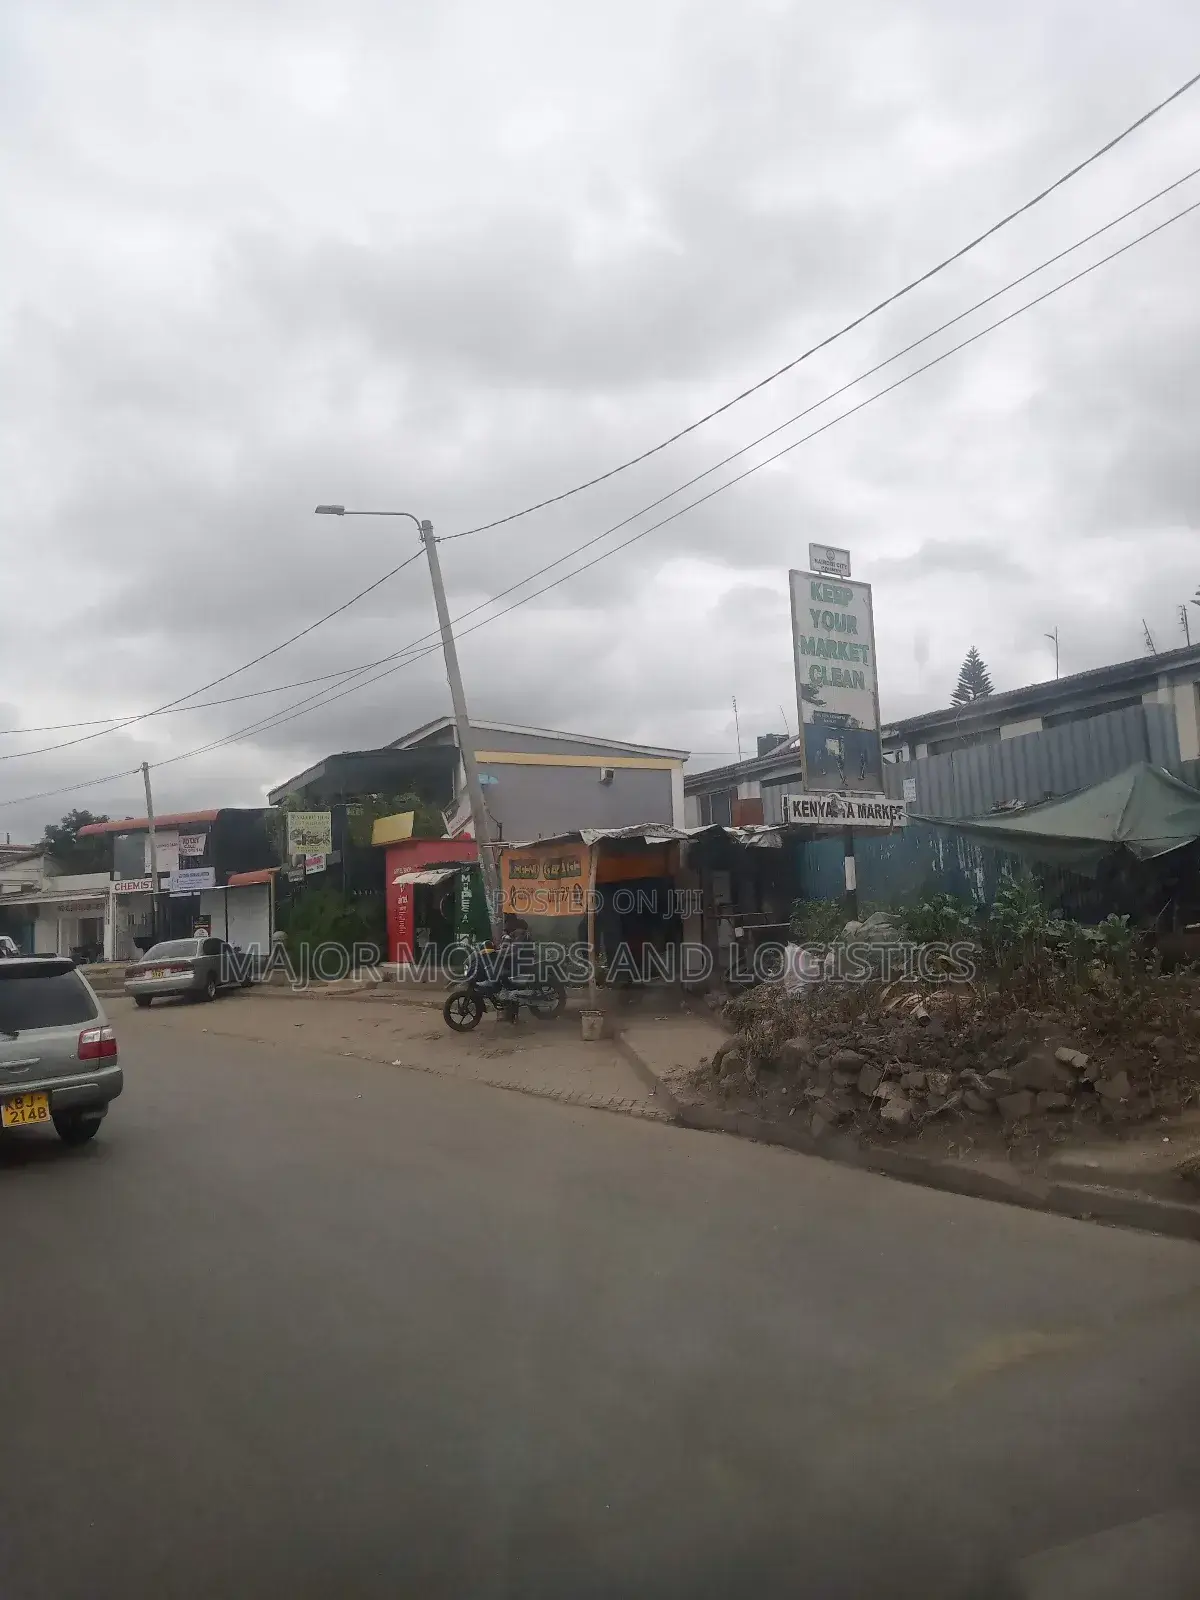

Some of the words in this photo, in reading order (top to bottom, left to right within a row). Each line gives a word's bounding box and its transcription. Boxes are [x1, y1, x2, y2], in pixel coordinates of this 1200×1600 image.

[810, 581, 854, 607] KEEP
[809, 608, 858, 636] YOUR
[799, 634, 870, 664] MARKET
[808, 664, 866, 690] CLEAN
[858, 804, 903, 820] MARKET
[10, 1106, 47, 1124] 214B
